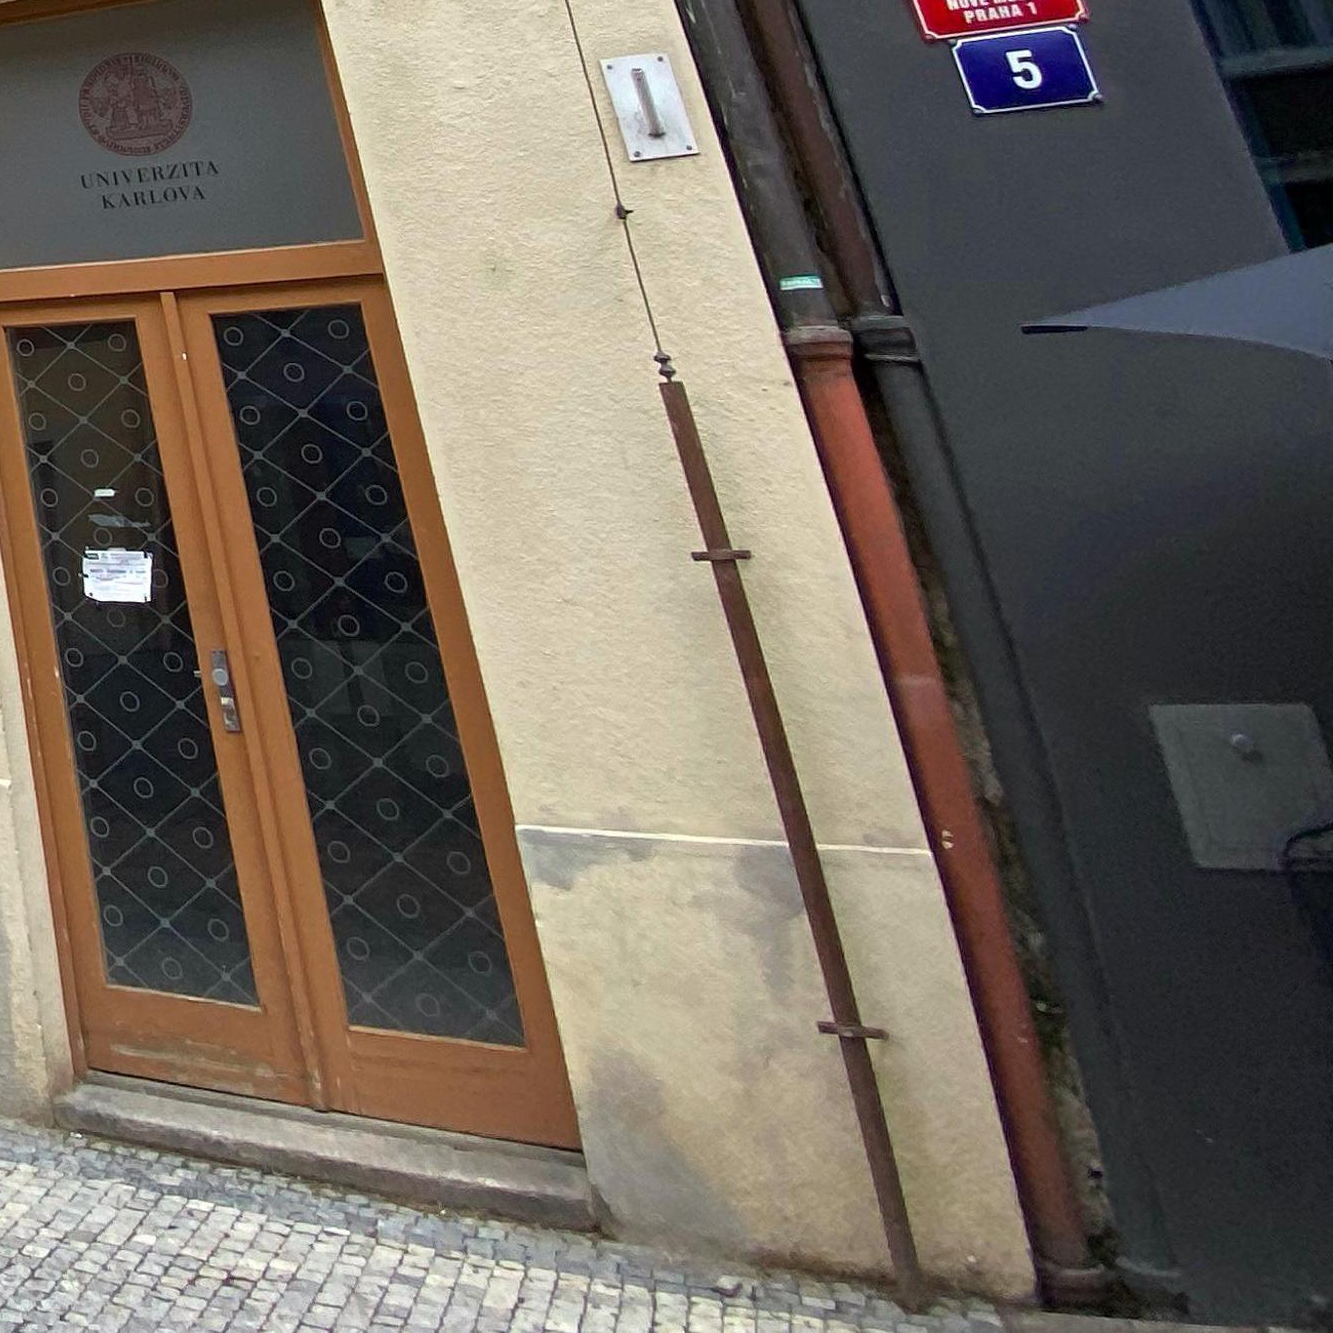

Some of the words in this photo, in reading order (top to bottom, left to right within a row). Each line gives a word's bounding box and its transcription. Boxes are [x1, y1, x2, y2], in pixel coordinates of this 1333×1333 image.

[963, 6, 1023, 23] PRAHA
[1027, 2, 1038, 15] 1
[1006, 49, 1043, 90] 5
[80, 160, 219, 189] UNIVERZITA
[101, 185, 206, 210] KARLOVA
